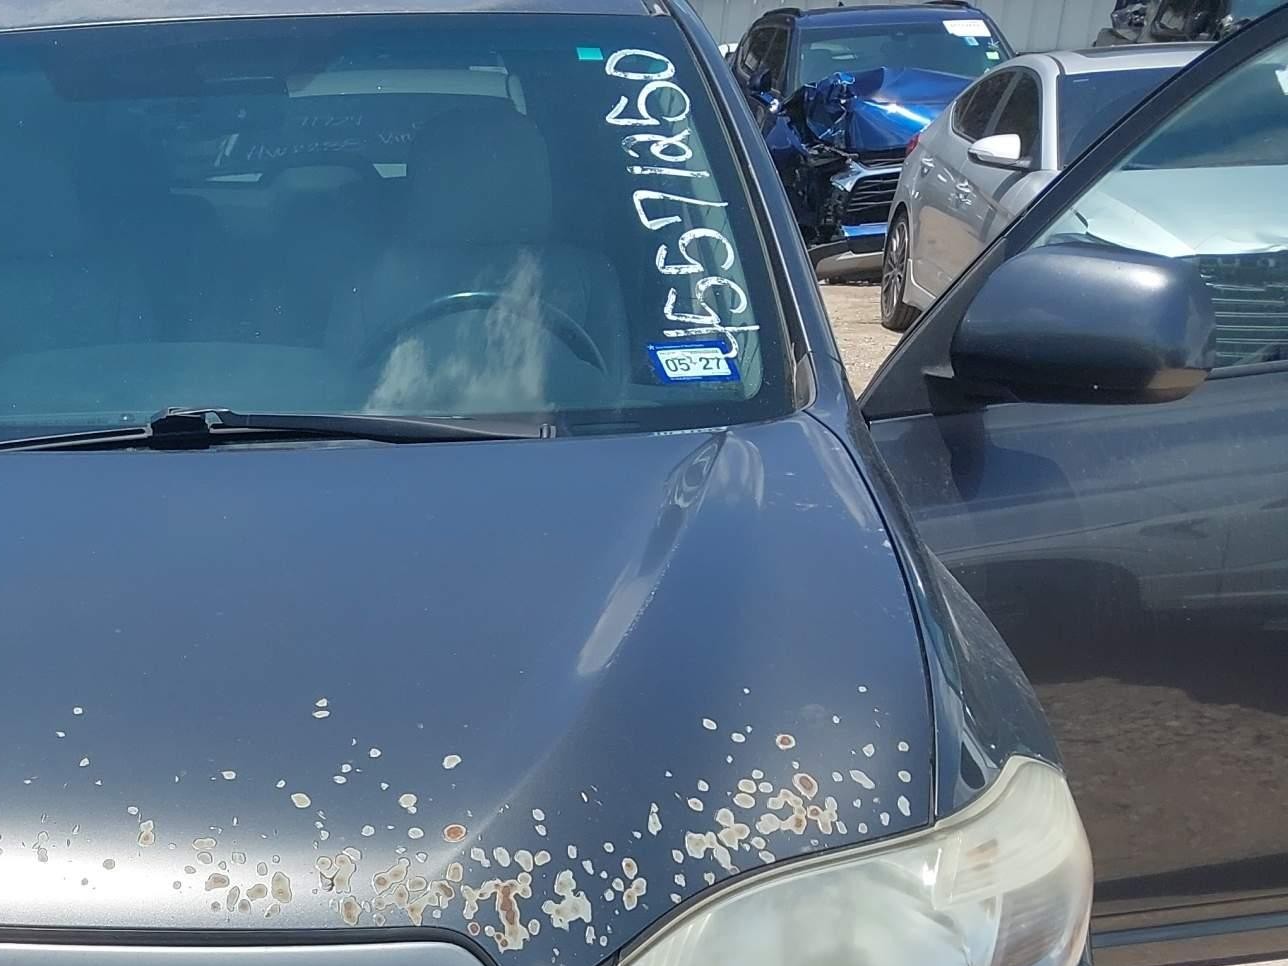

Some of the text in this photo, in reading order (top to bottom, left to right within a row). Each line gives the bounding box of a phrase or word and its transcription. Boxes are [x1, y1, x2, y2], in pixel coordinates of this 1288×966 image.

[605, 49, 760, 358] 45571250
[665, 356, 721, 372] 05 27
